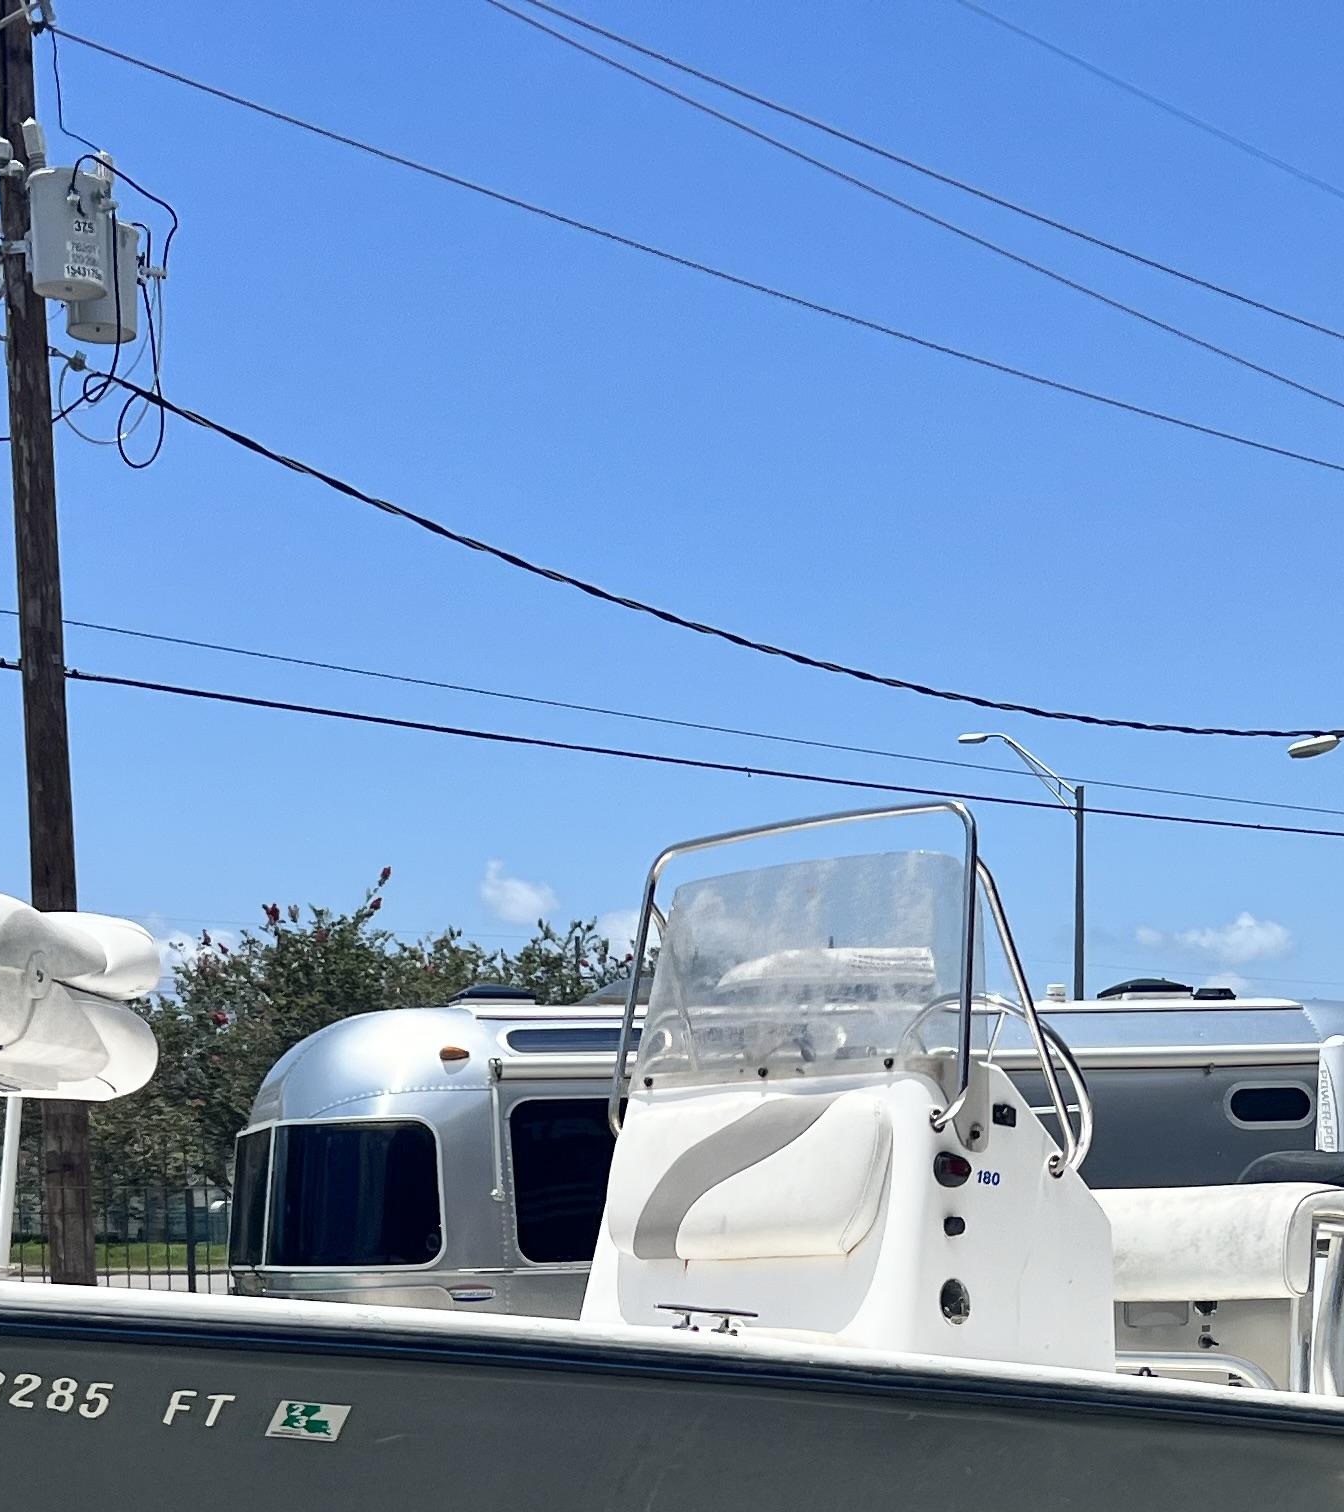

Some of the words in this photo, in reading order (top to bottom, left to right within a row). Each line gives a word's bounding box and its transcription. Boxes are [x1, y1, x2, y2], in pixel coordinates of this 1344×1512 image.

[1320, 1069, 1335, 1150] POWER-PO
[977, 1169, 1001, 1186] 180
[161, 1390, 237, 1428] FT
